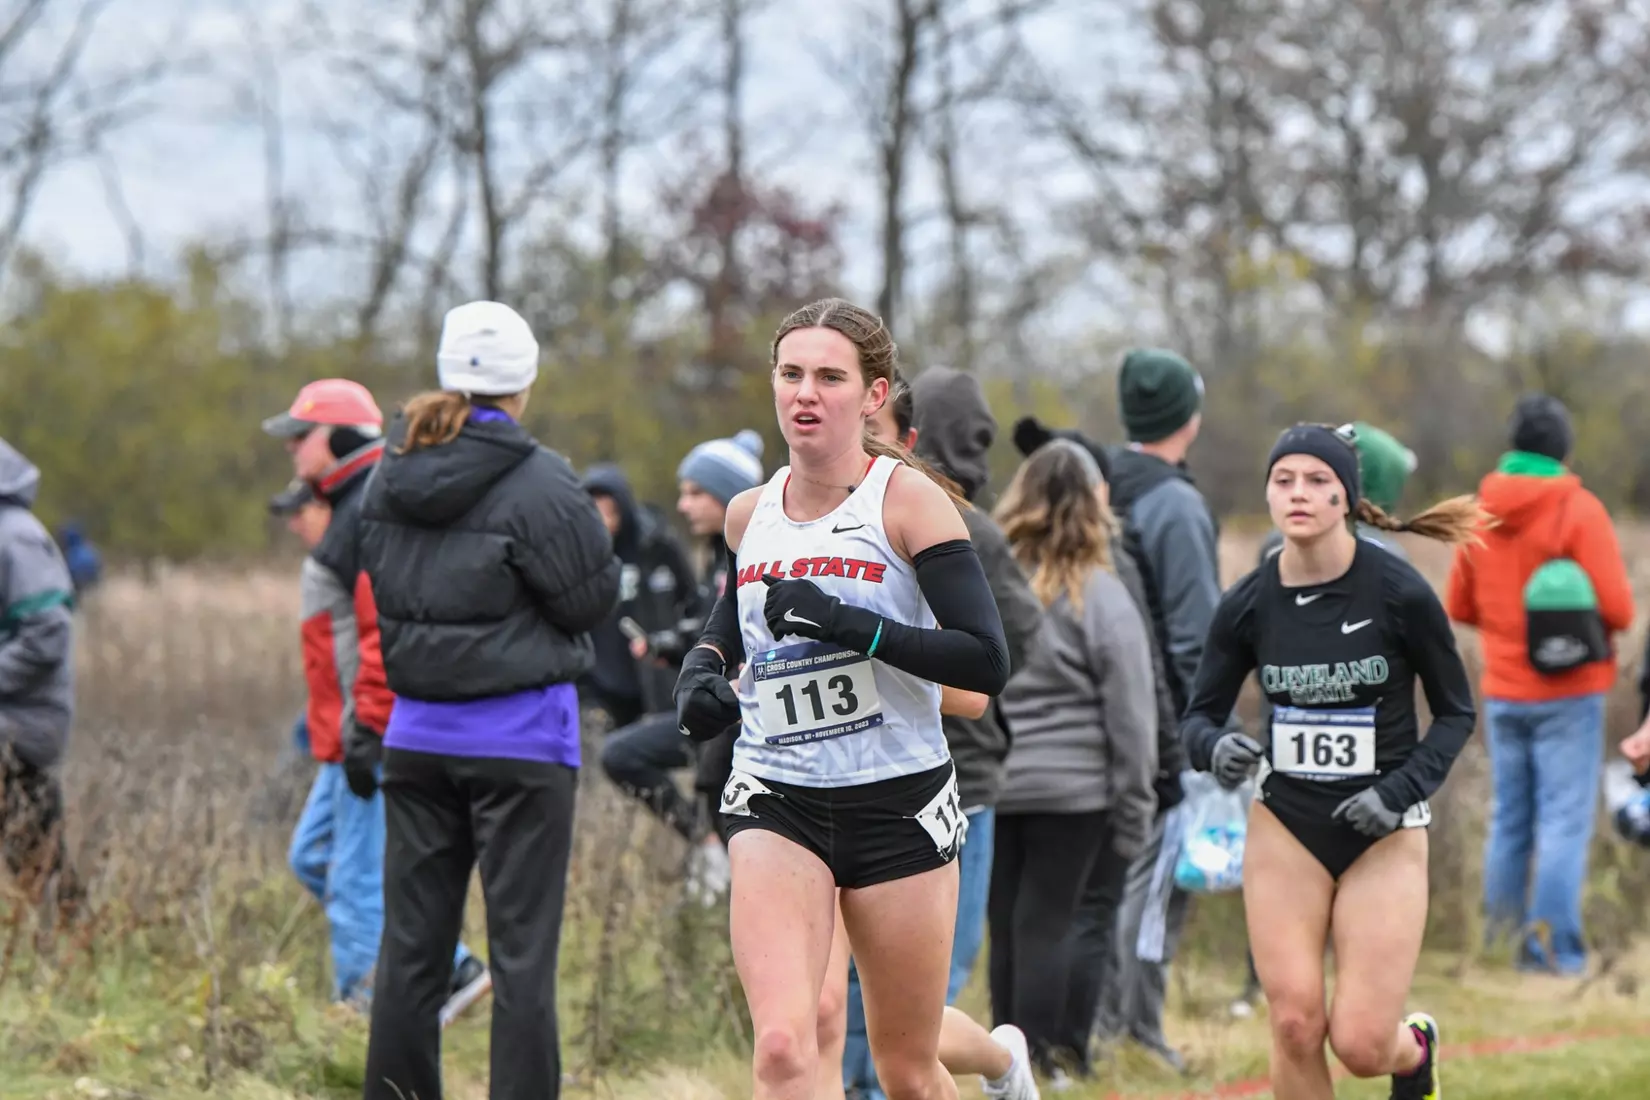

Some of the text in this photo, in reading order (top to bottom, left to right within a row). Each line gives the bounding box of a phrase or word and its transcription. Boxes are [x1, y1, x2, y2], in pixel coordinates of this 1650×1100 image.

[790, 557, 886, 583] STATE
[766, 662, 786, 672] CROSS
[787, 658, 813, 669] COUNTRY
[814, 650, 860, 664] CHAMPIONSH
[1262, 655, 1388, 693] CLEVELAND
[776, 674, 858, 726] 113
[816, 726, 844, 738] NOVEMBER
[854, 720, 869, 730] 2023
[1290, 732, 1357, 767] 163
